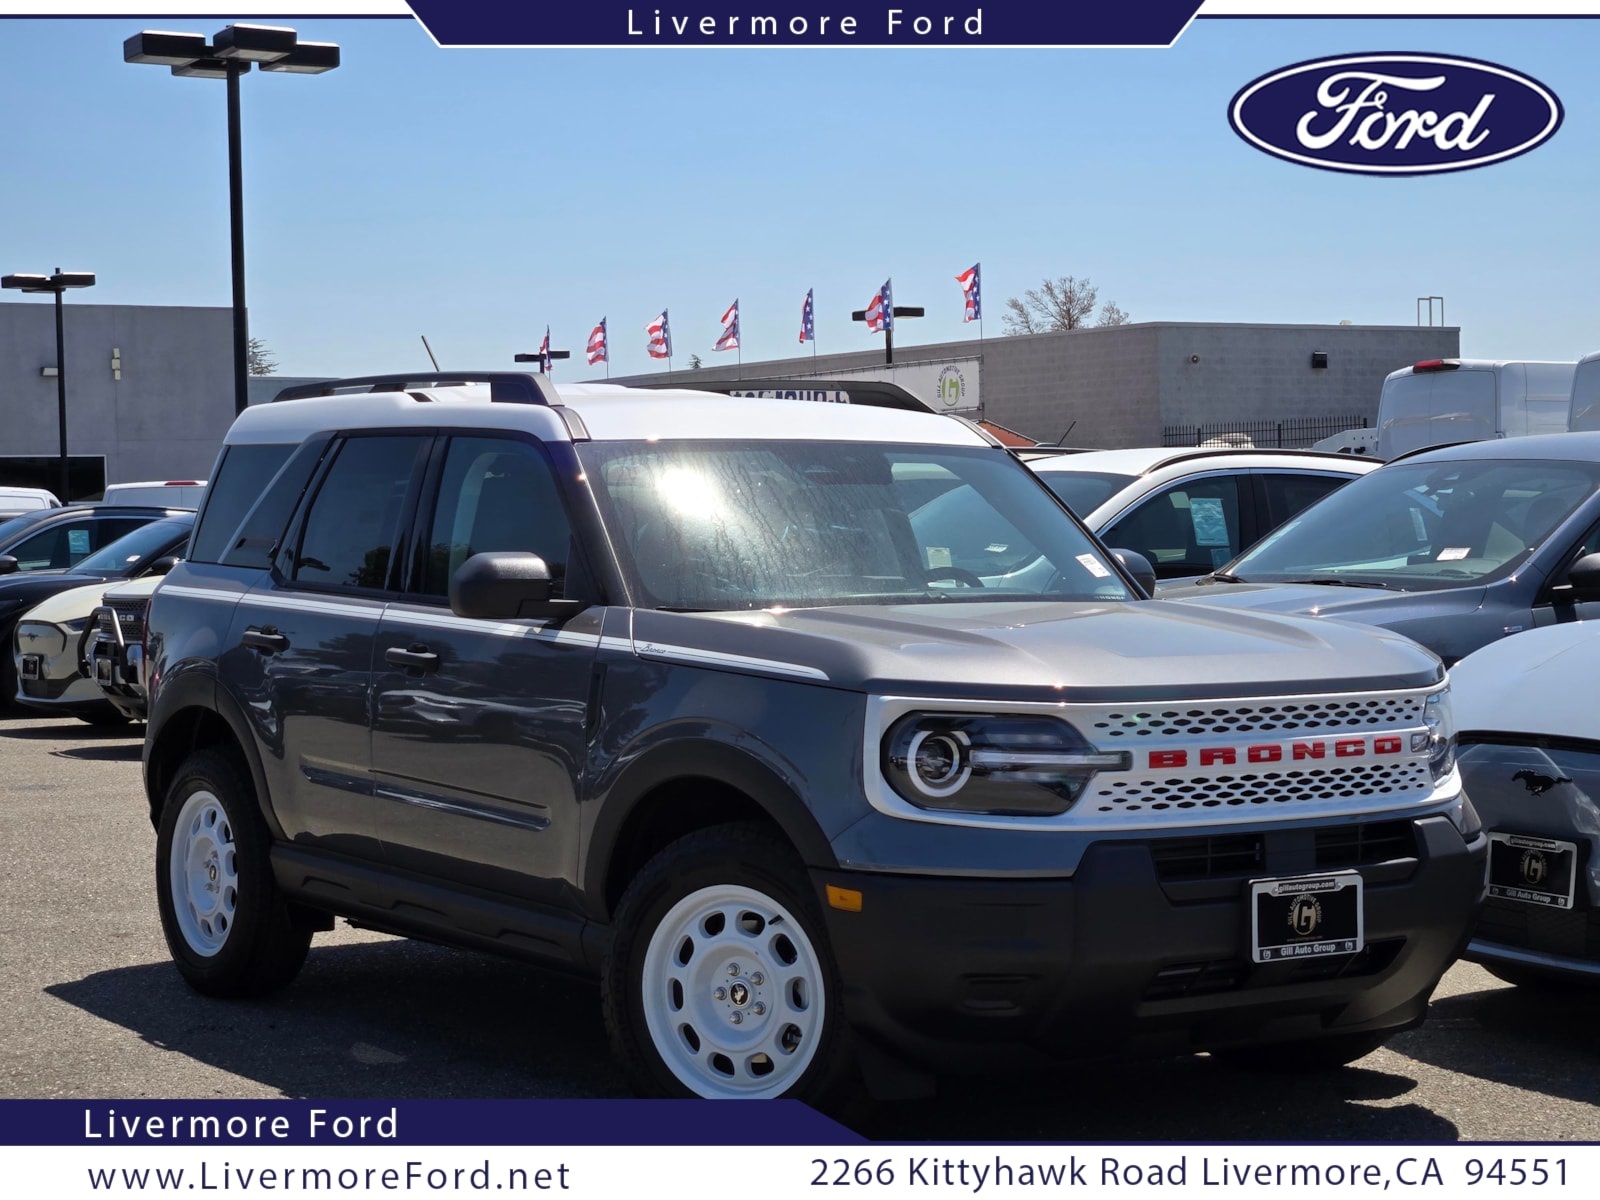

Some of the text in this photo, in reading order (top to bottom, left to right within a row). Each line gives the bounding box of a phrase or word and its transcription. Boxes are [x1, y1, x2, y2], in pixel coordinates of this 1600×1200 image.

[1148, 735, 1403, 769] BRONCO
[1279, 881, 1335, 893] gillautogroup.com
[1517, 891, 1532, 899] Auto
[1532, 893, 1551, 903] Group
[1280, 944, 1336, 956] Gill Auto Group
